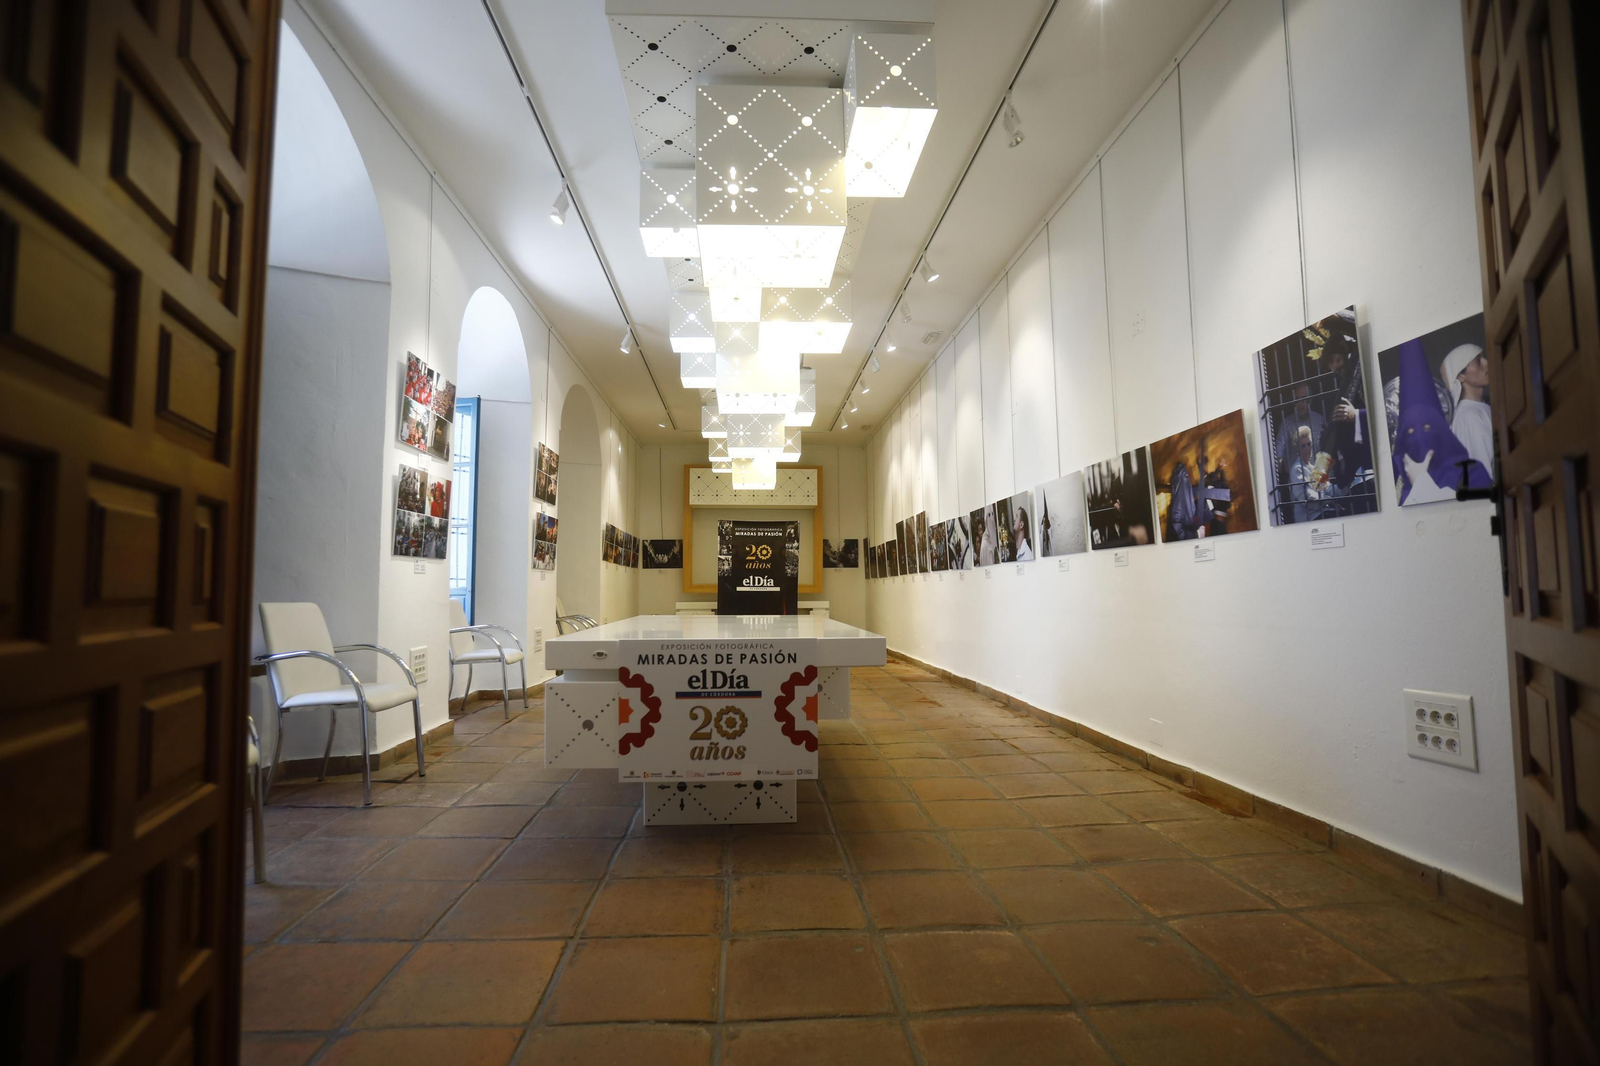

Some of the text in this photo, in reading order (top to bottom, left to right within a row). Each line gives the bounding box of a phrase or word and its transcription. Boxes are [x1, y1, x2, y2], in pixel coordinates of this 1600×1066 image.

[745, 560, 771, 569] años
[637, 650, 797, 665] MIRADAS DE PASIÓN
[690, 742, 747, 760] años
